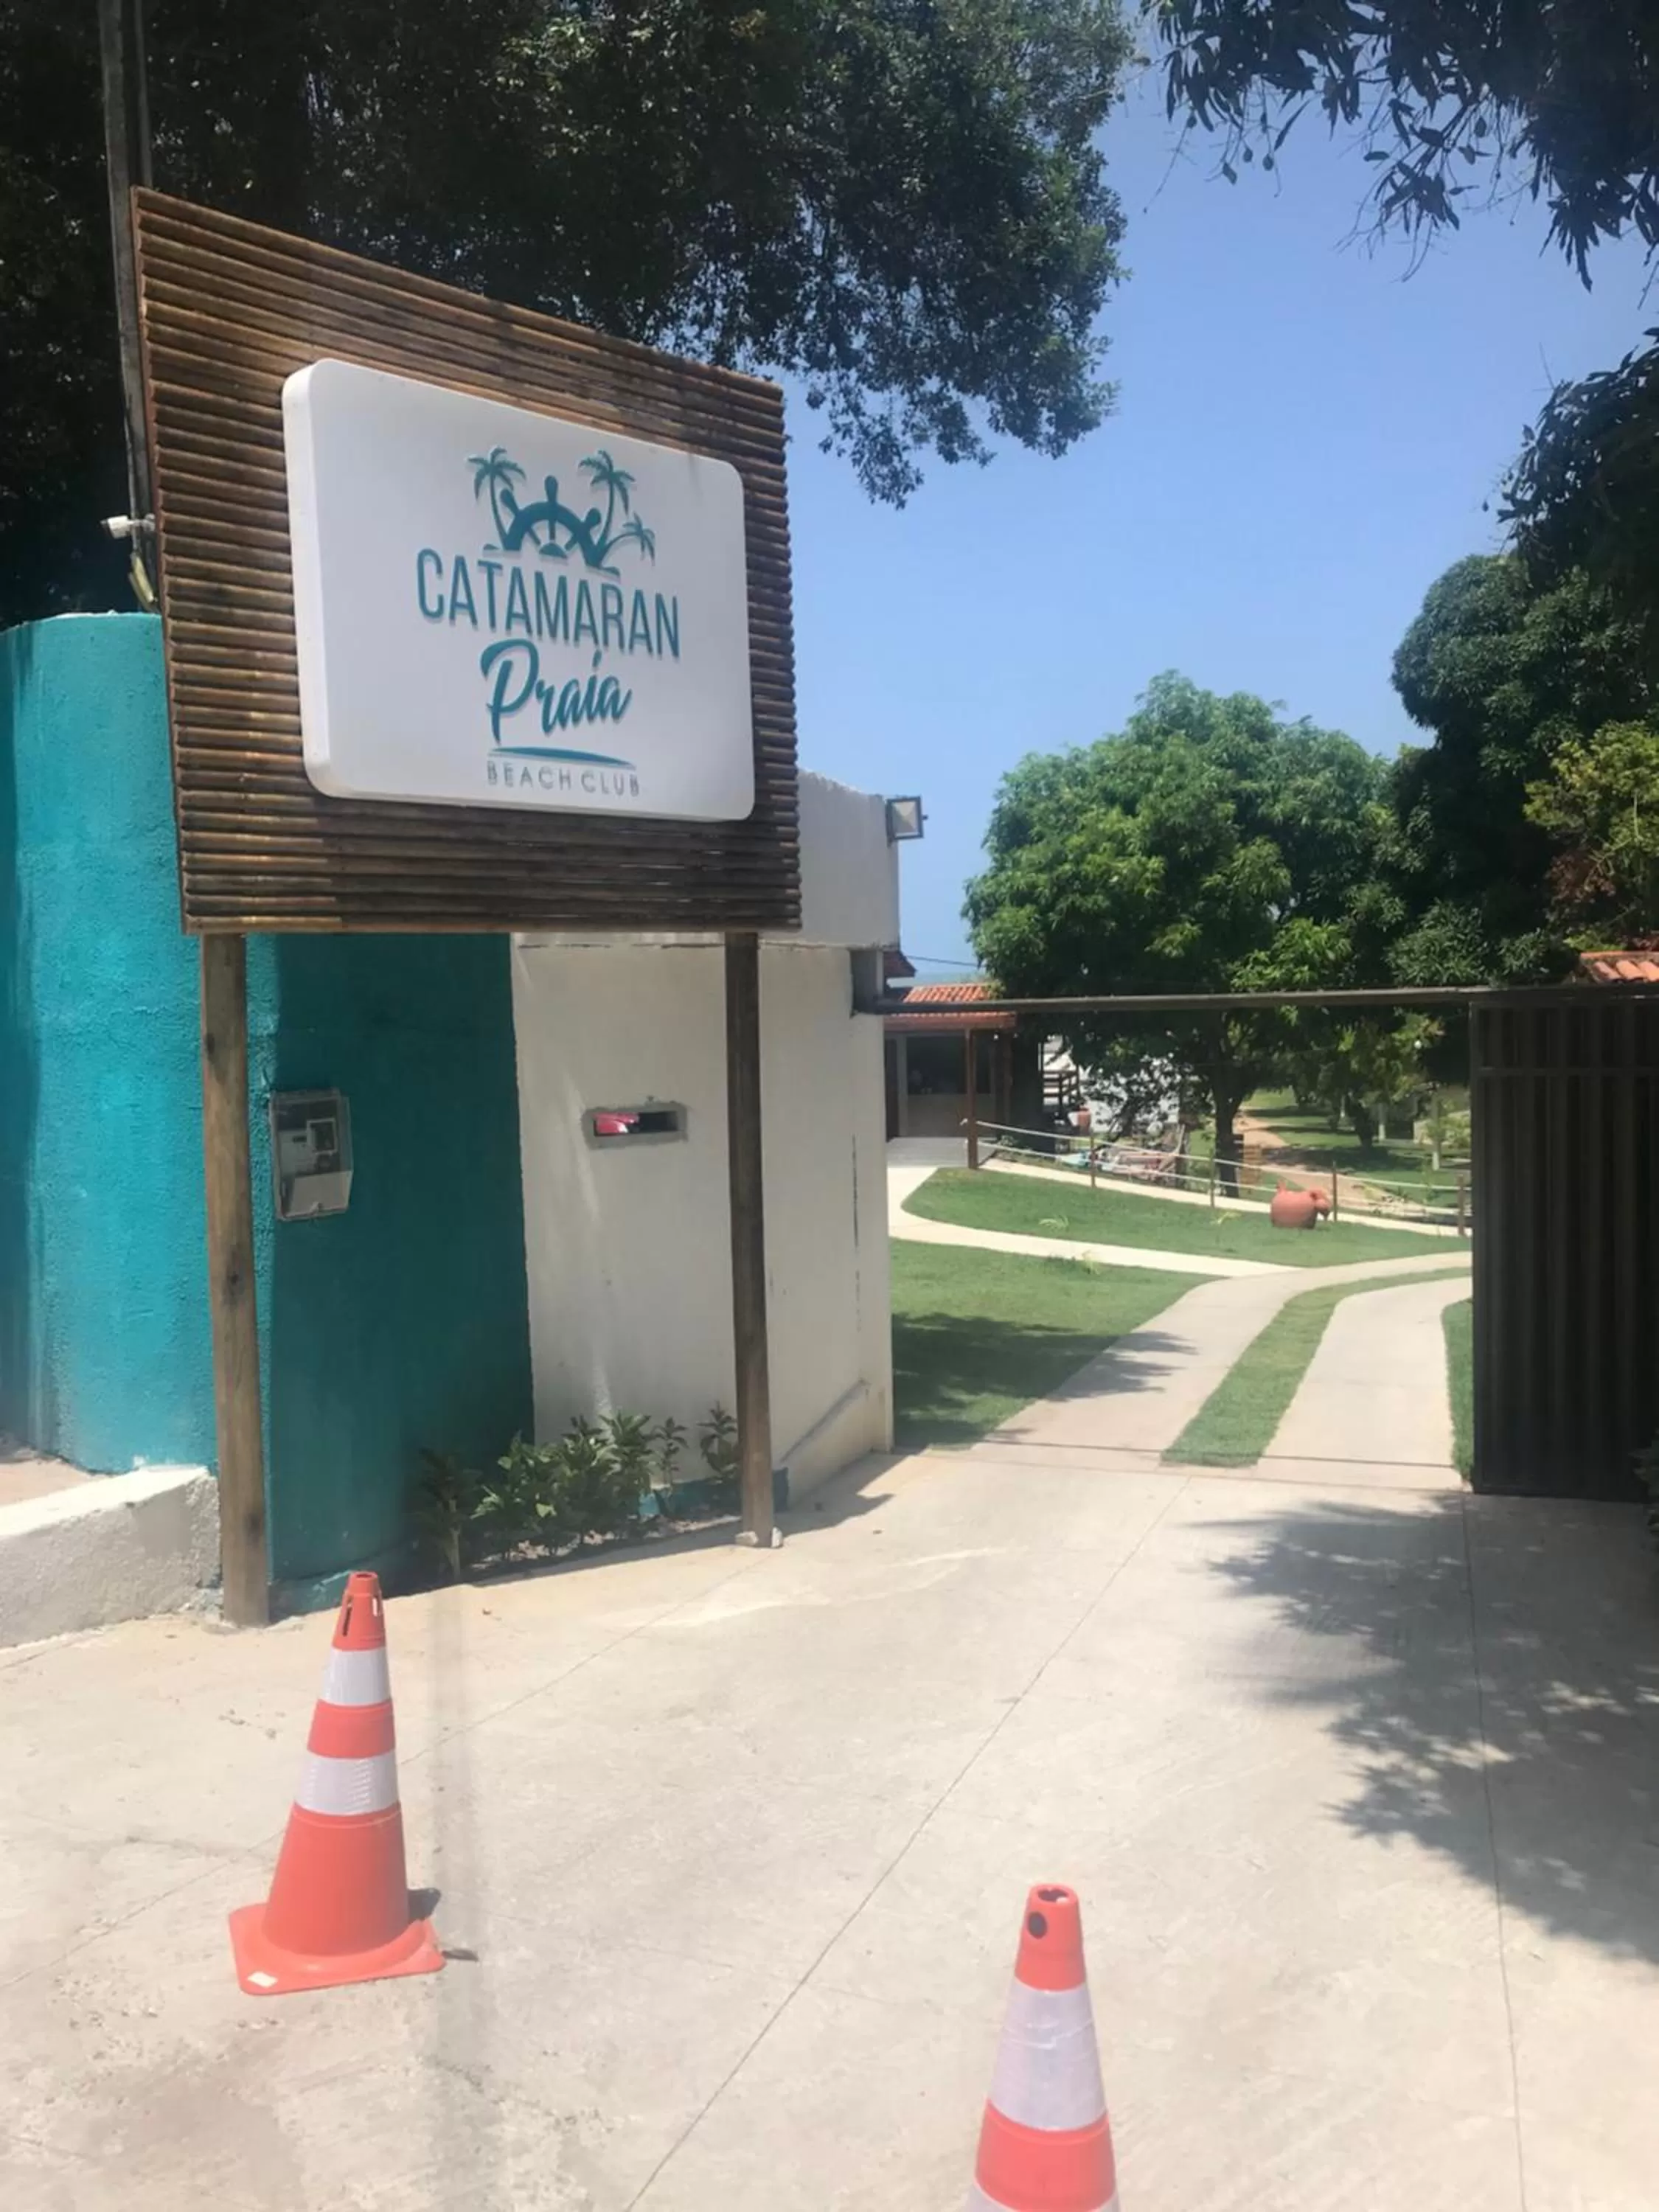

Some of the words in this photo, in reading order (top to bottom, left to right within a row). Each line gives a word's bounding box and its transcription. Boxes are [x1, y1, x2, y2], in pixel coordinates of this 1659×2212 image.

[417, 548, 680, 658] CATAMARAN
[481, 639, 632, 745] Praia
[487, 761, 571, 791] BEACH
[580, 766, 640, 797] CLUB
